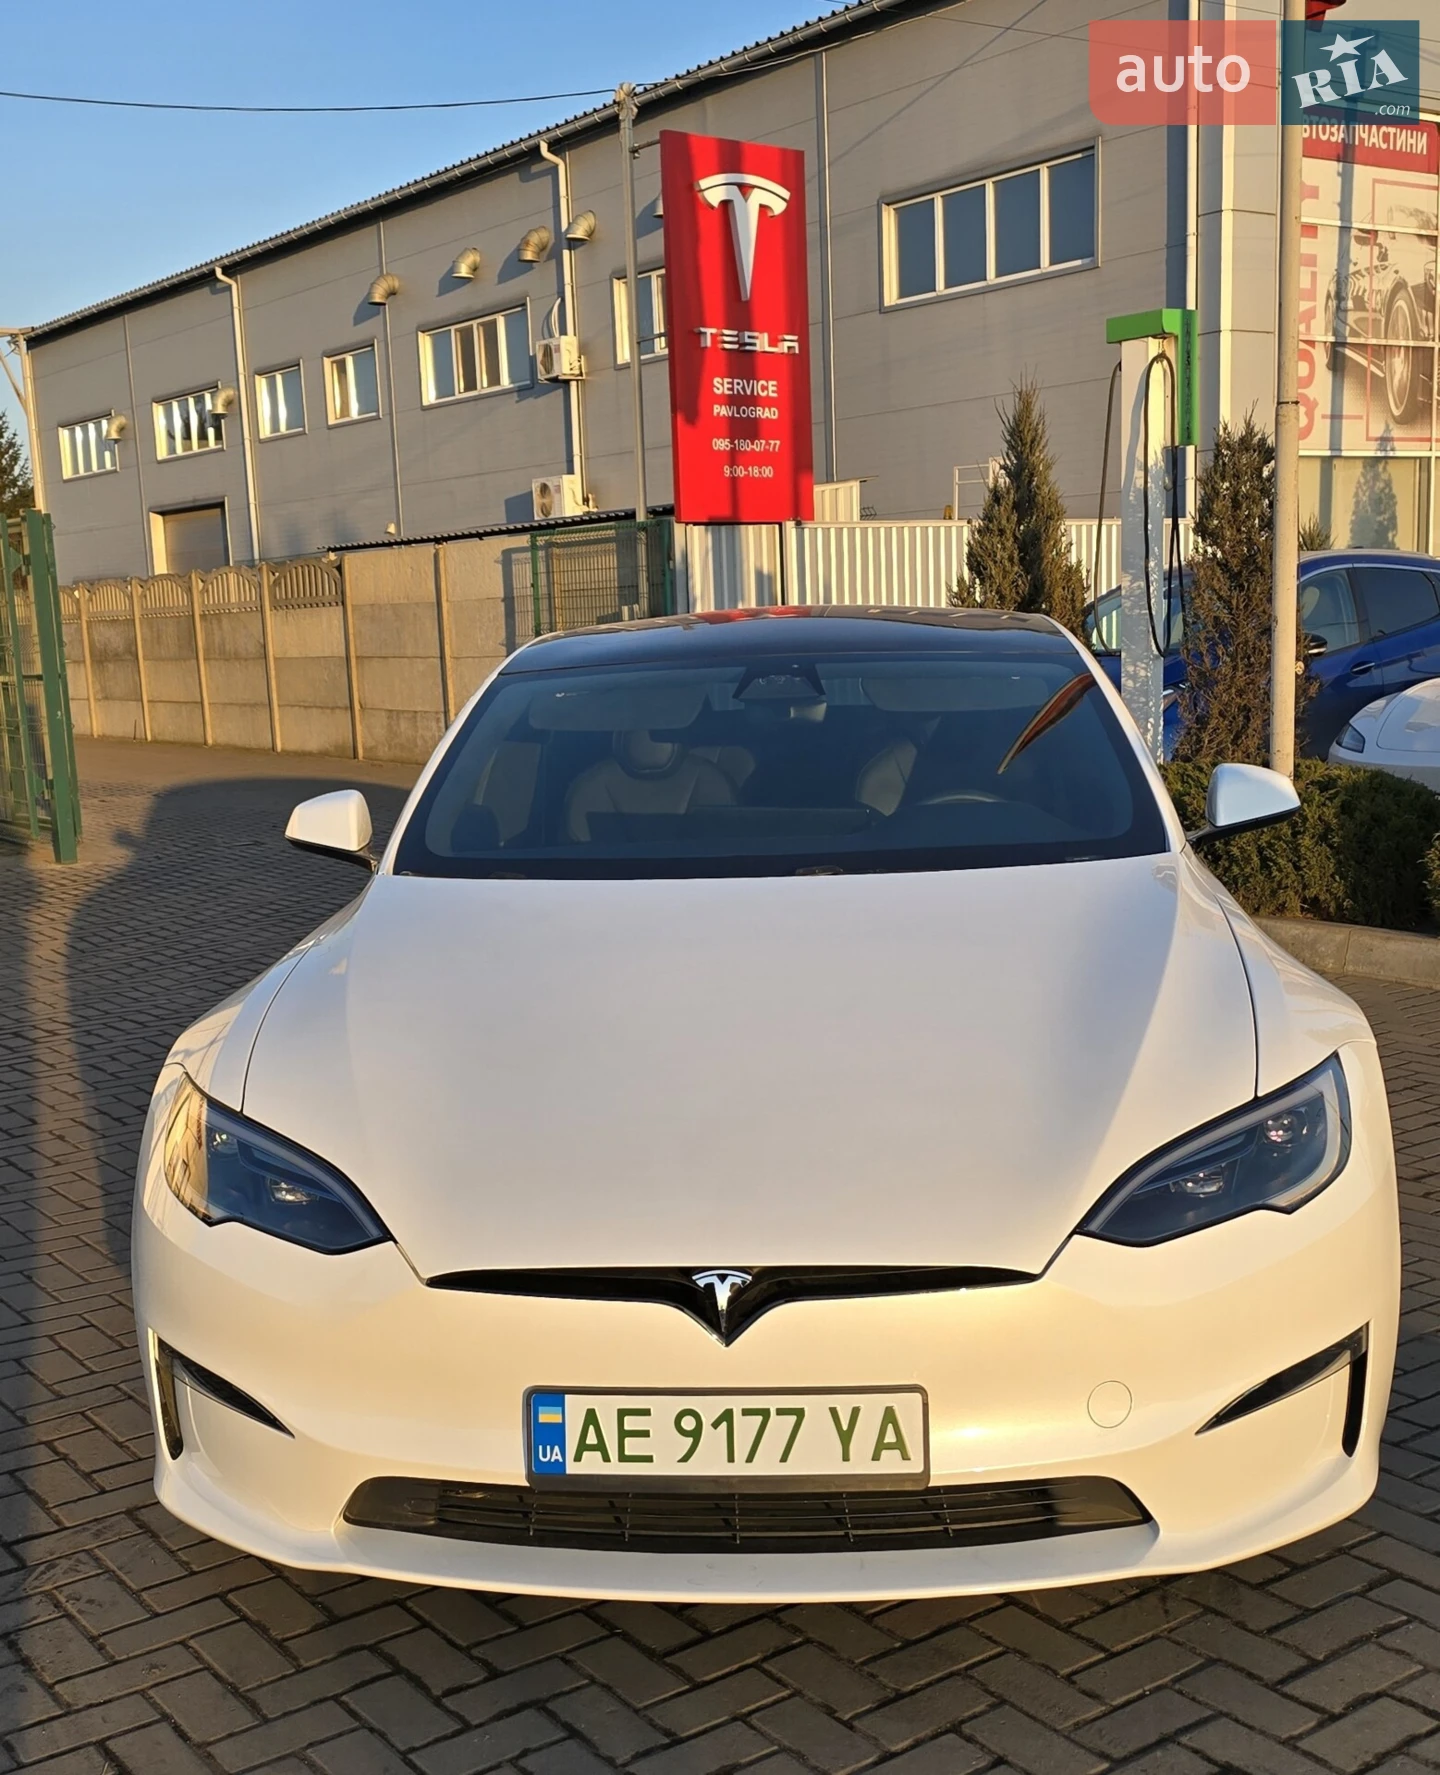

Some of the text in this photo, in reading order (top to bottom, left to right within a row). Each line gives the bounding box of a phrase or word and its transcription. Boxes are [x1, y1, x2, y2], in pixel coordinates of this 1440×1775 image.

[1302, 114, 1428, 155] ВТОЗАПЧАСТИНИ
[694, 327, 799, 354] TESLA
[713, 377, 778, 397] SERVICE
[713, 404, 779, 419] PAVLOGRAD
[712, 438, 780, 452] 095-180-07-77
[723, 465, 773, 477] 9:00-18:00
[573, 1405, 911, 1463] AE 9177 YA
[538, 1445, 563, 1463] UA
